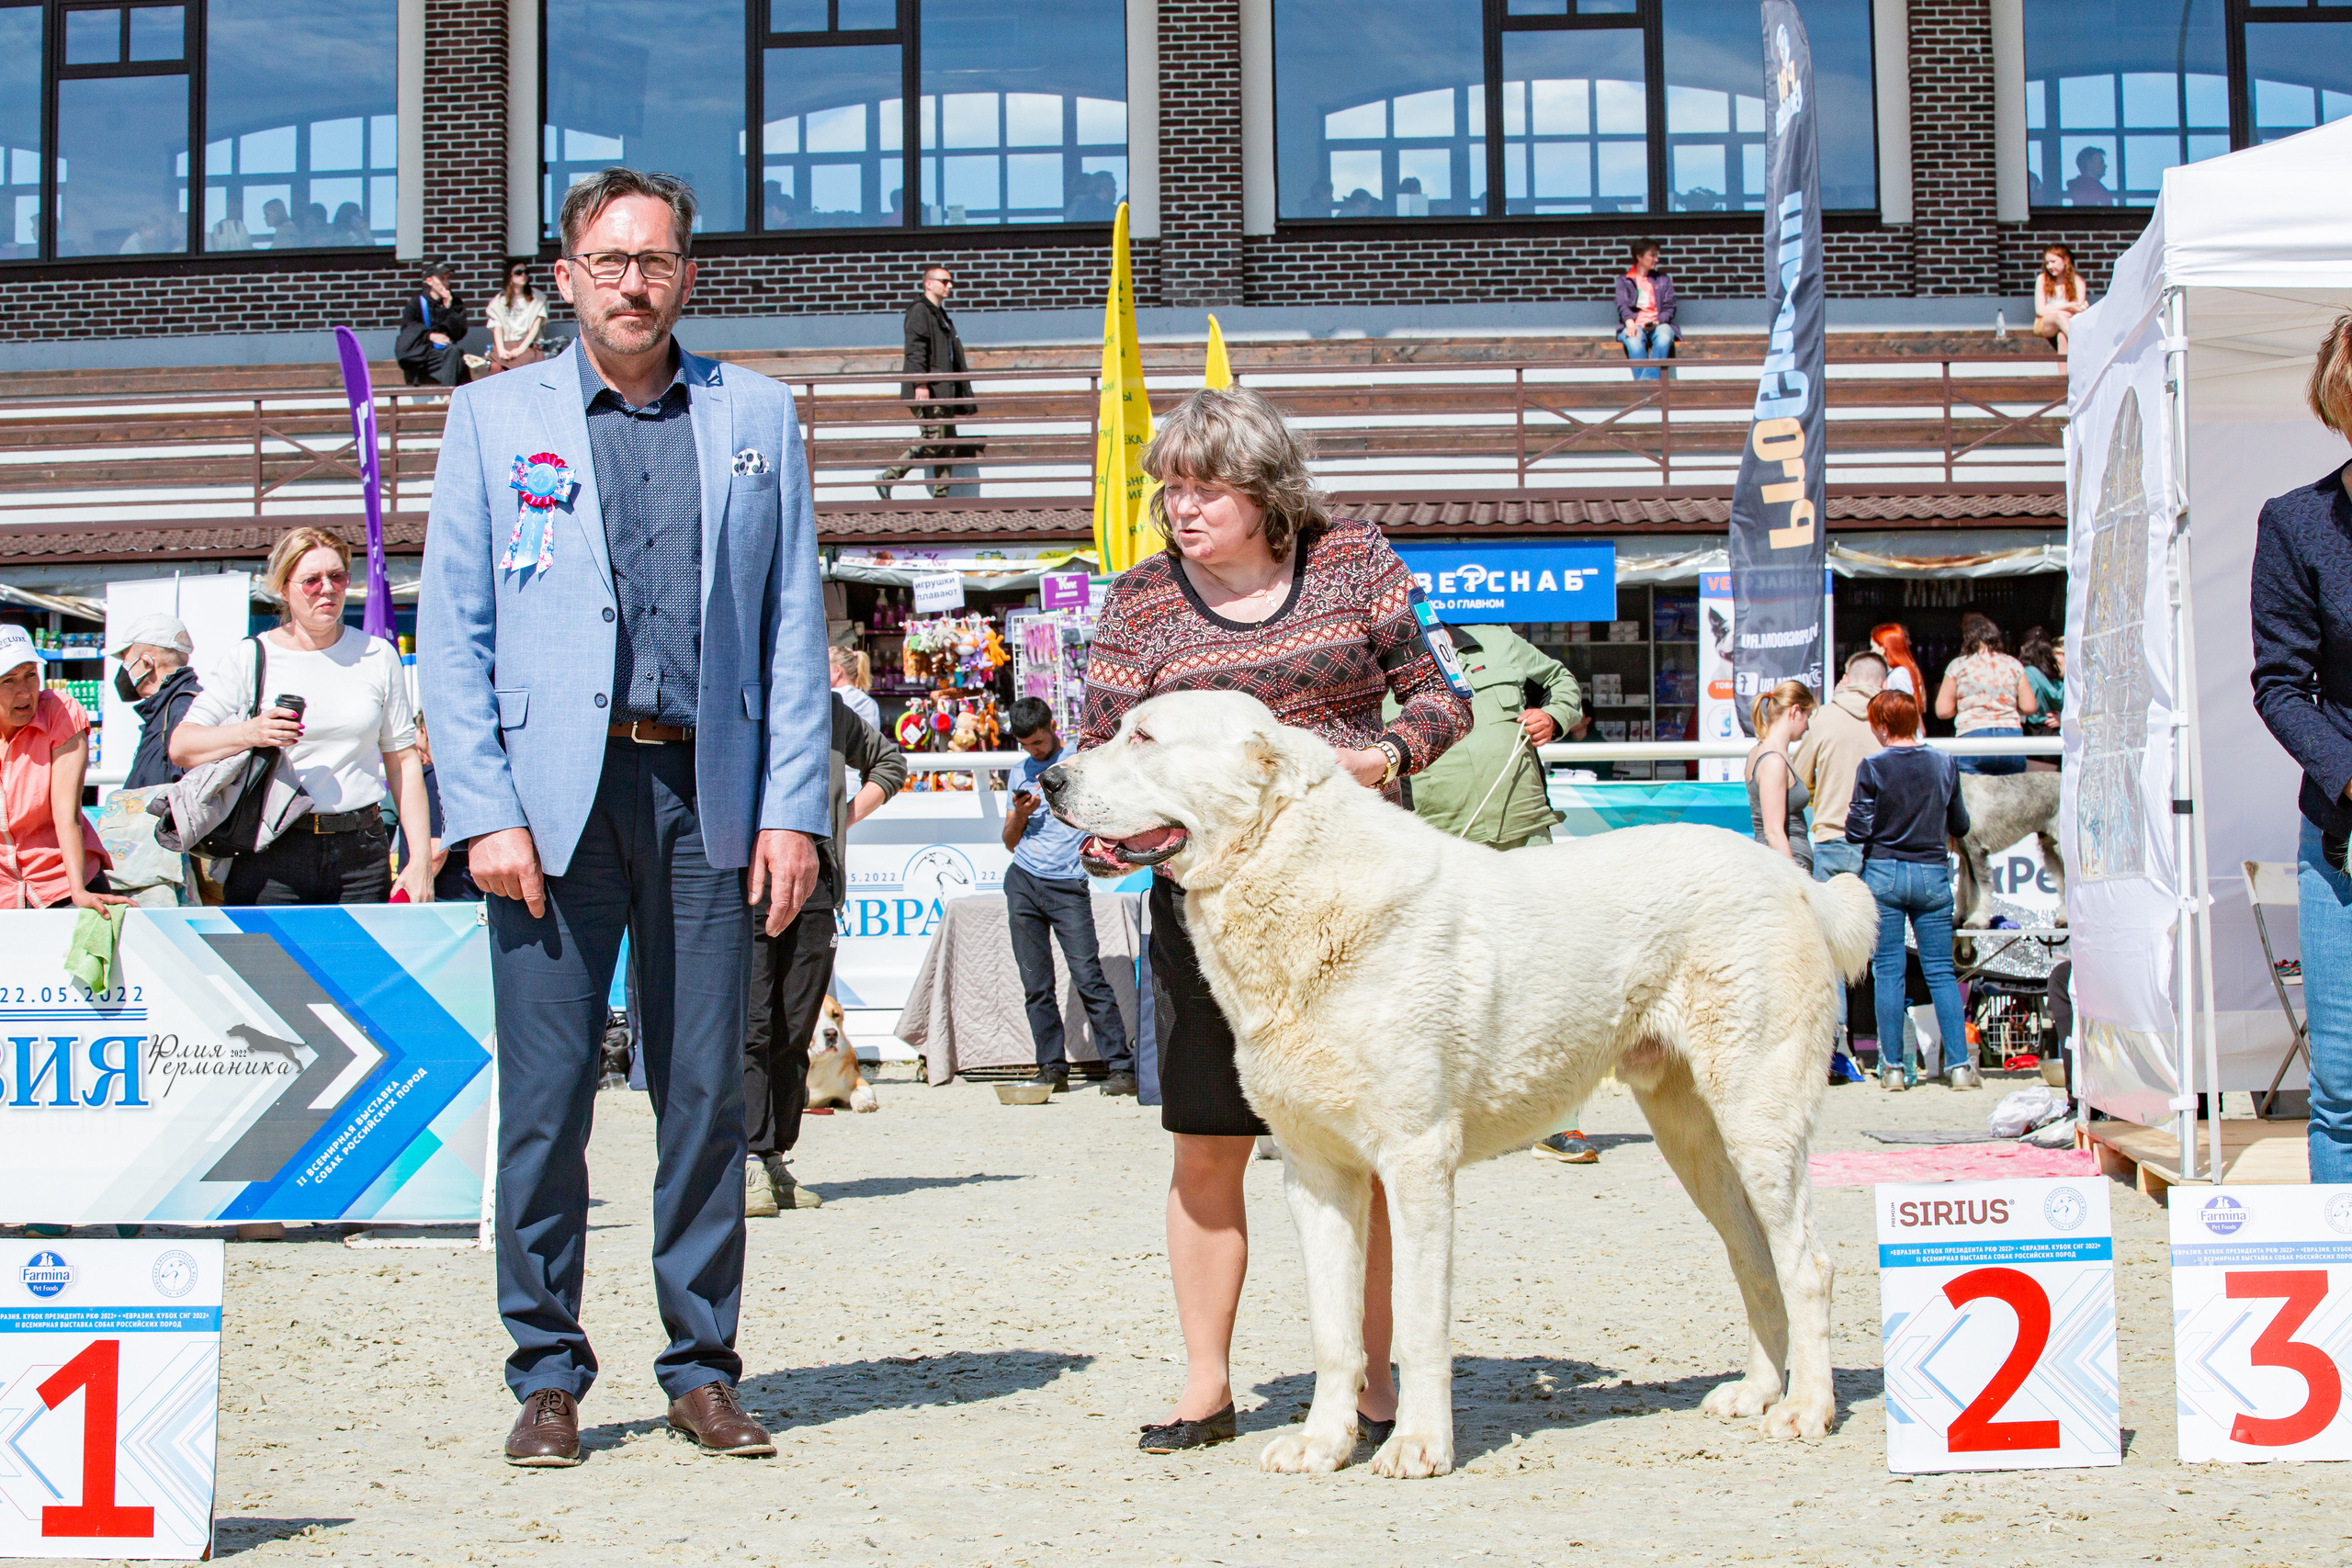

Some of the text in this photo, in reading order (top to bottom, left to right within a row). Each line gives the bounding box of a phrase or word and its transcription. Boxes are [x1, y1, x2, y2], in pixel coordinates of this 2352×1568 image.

[915, 578, 956, 591] игрушки
[917, 589, 957, 601] плавают
[1447, 600, 1453, 609] О
[1457, 599, 1504, 609] ГЛАВНОМ
[846, 873, 896, 882] 5.2022
[148, 1034, 247, 1057] Юлия 2022
[0, 1036, 150, 1106] ИЯ
[306, 1124, 356, 1177] ВСЕМИРНАЯ
[355, 1081, 400, 1126] ВЫСТАВКА
[314, 1067, 427, 1184] СОБАК РОССИЙСКИХ ПОРОД
[1900, 1199, 2009, 1226] SIRIUS
[2200, 1211, 2246, 1221] Farmina
[23, 1269, 70, 1280] Farmina
[1941, 1267, 2061, 1453] 2
[2224, 1269, 2342, 1447] 3
[36, 1339, 154, 1538] 1
